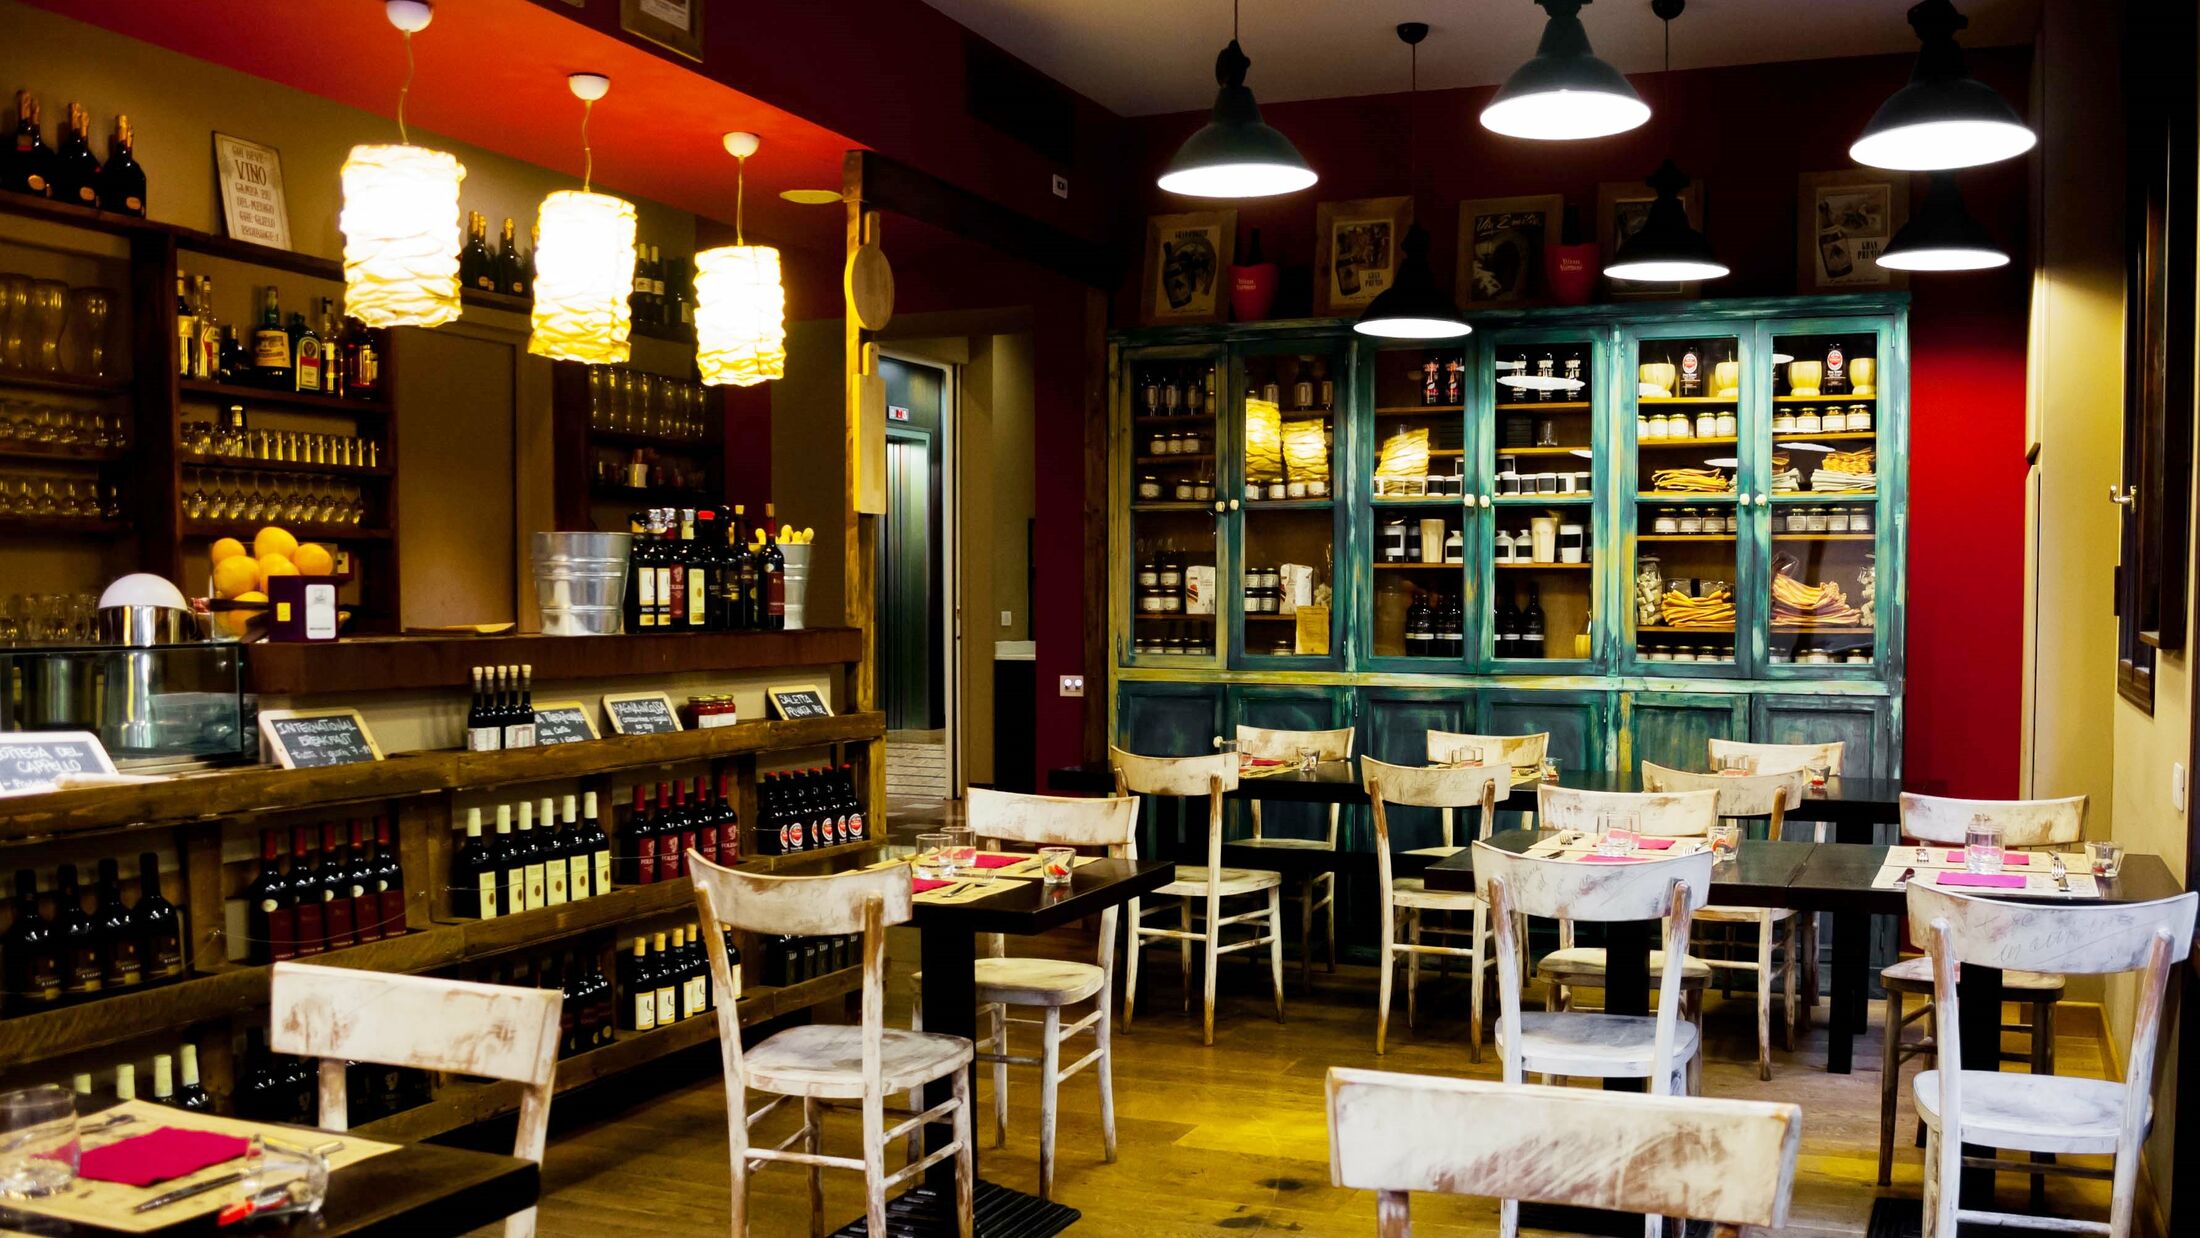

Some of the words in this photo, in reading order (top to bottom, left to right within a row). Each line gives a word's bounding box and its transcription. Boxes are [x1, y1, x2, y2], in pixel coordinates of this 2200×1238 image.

[235, 159, 267, 186] VINO
[778, 694, 813, 704] SALETTA
[276, 718, 357, 735] INTERNATIONAL
[55, 745, 84, 759] DEL
